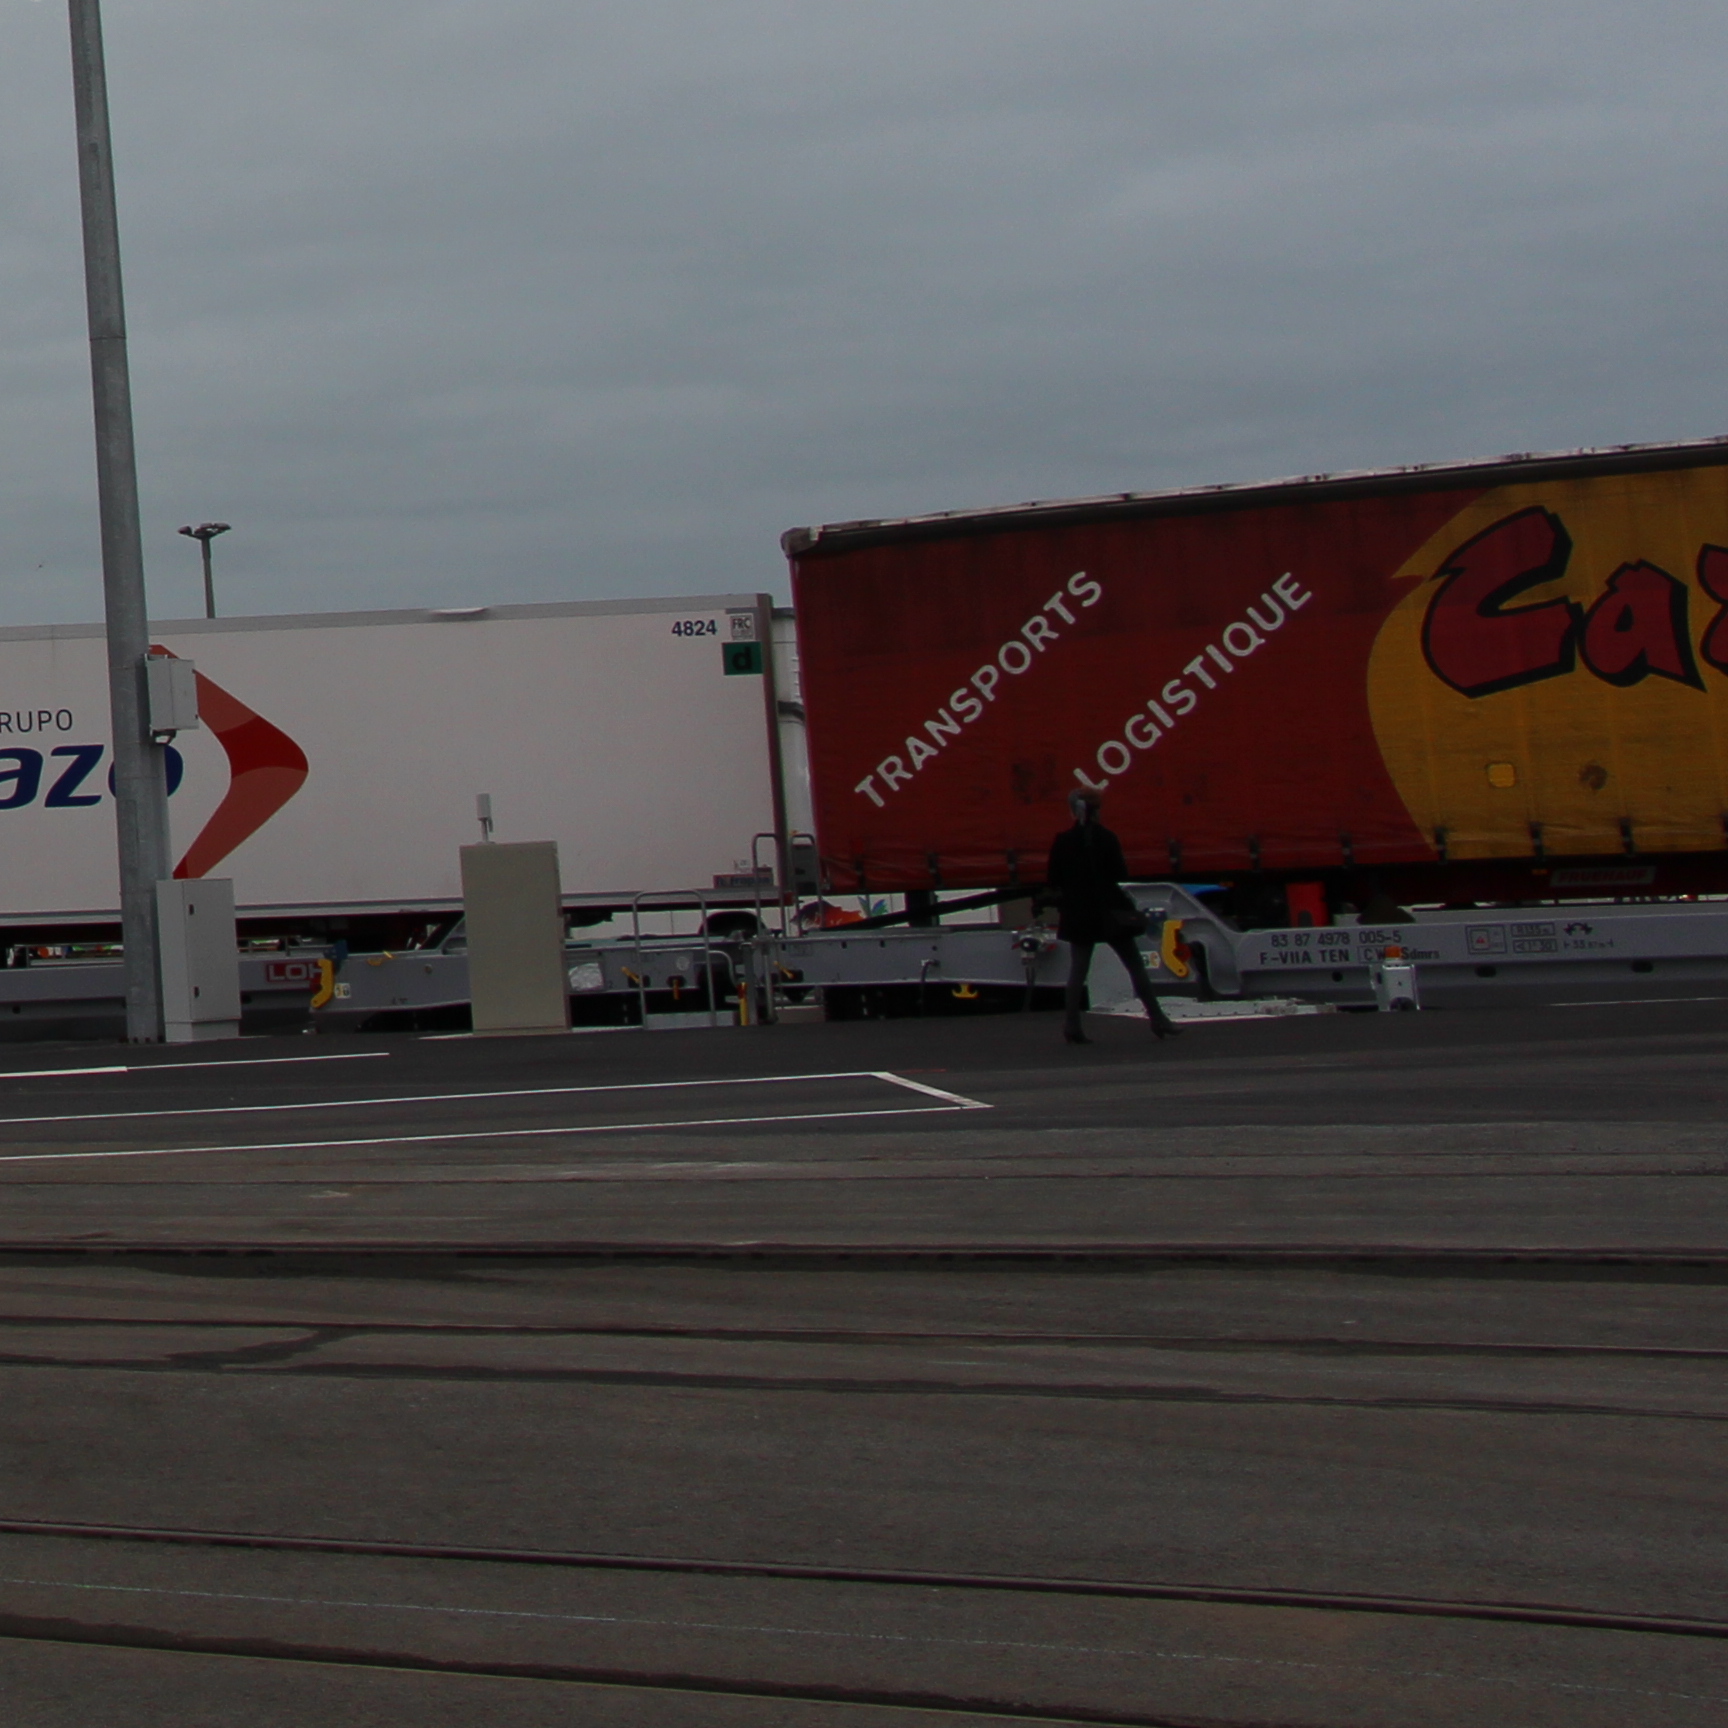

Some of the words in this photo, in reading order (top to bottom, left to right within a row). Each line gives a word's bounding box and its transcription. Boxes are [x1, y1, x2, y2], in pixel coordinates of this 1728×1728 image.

[671, 619, 717, 637] 4824
[732, 617, 752, 630] FRC
[731, 646, 753, 672] d
[854, 571, 1103, 808] TRANSPORTS
[1072, 571, 1313, 792] LOGISTIQUE
[1272, 934, 1288, 947] 83
[1294, 933, 1310, 946] 87
[1317, 932, 1350, 945] 4978
[1359, 930, 1402, 944] 005-5
[1319, 949, 1350, 962] TEN
